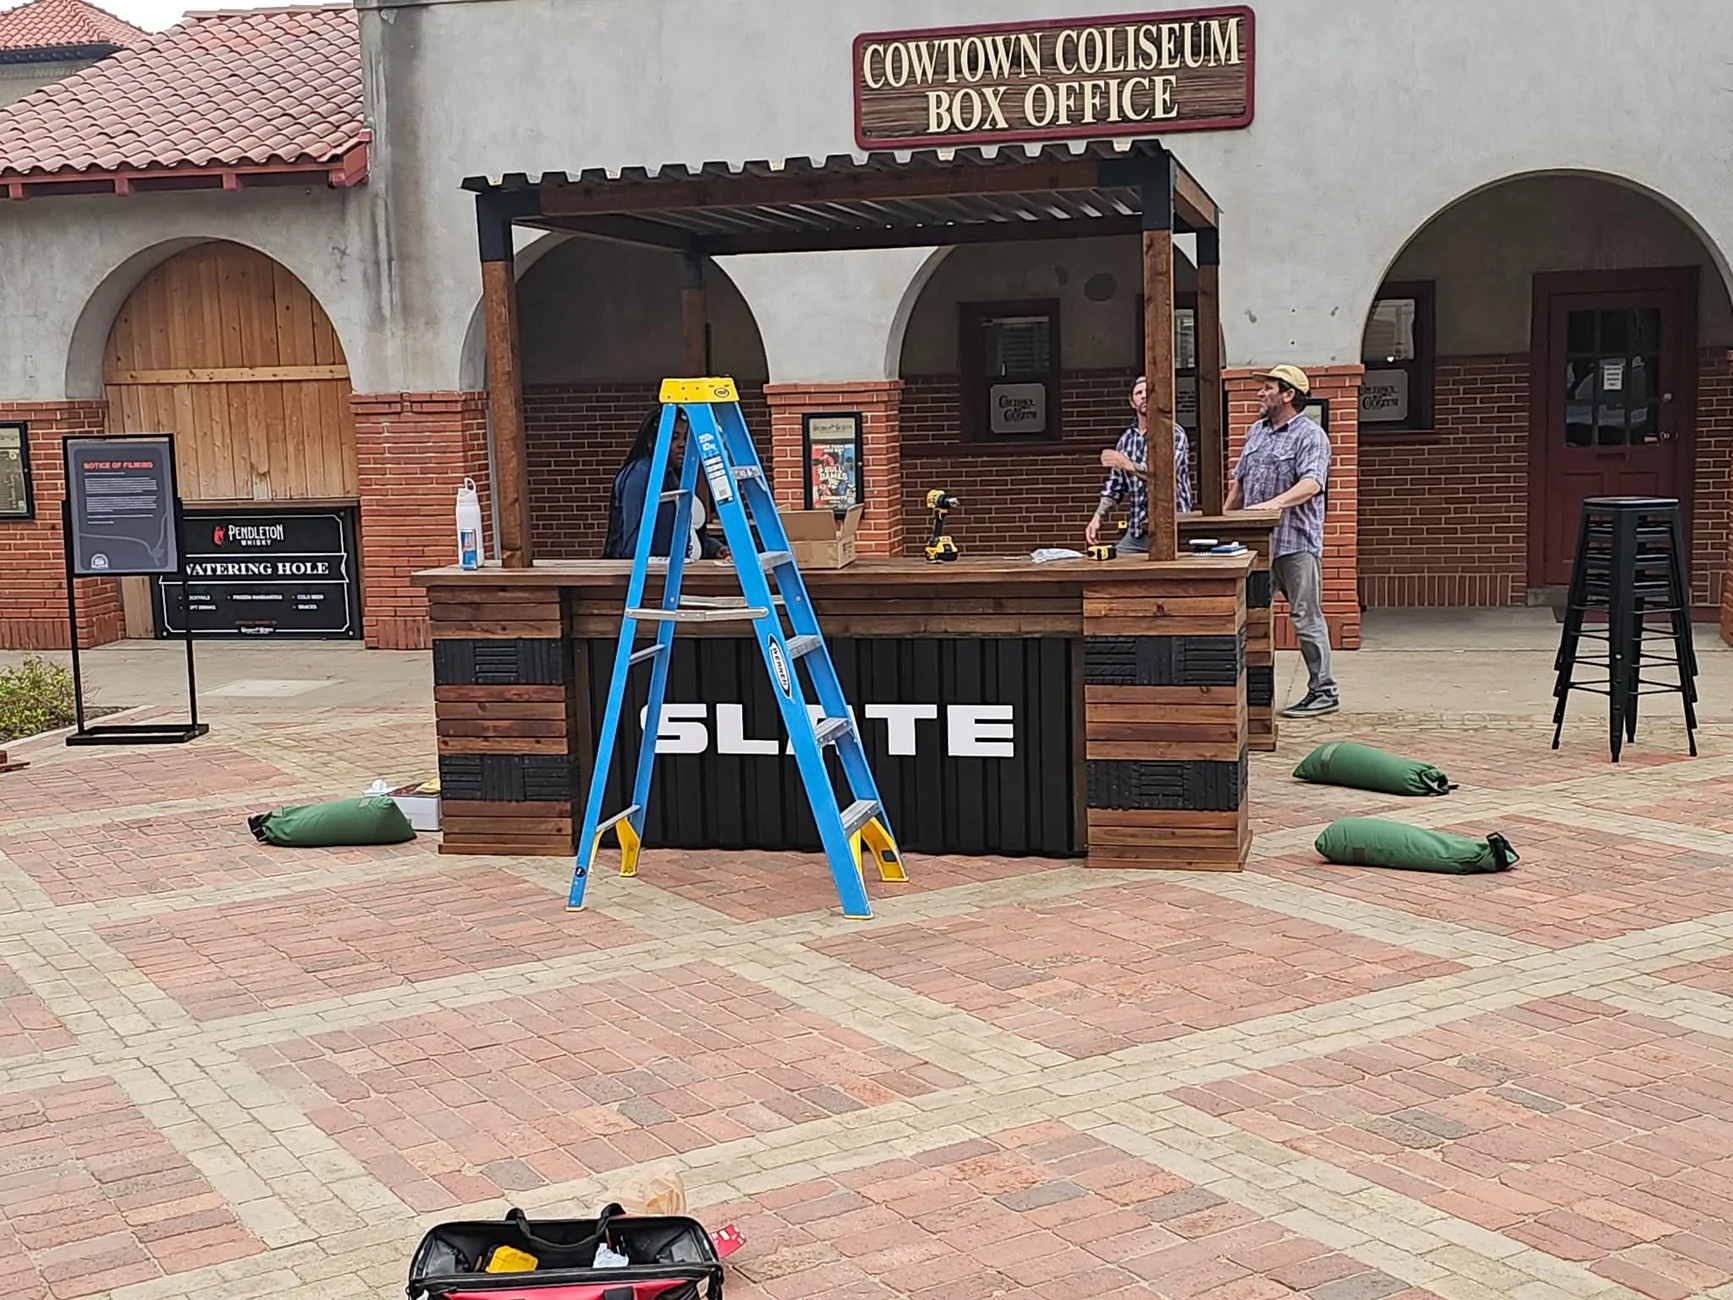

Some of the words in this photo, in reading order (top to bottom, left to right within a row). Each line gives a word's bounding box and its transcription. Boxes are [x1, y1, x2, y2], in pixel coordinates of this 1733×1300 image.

[863, 32, 1042, 89] COWTOWN
[1055, 17, 1242, 76] COLISEUM
[925, 85, 1009, 134] BOX
[1024, 75, 1179, 127] OFFICE
[83, 461, 110, 469] NOTICE
[228, 524, 284, 541] PENDLETON
[276, 562, 330, 575] HOLE
[772, 647, 789, 687] WERNER
